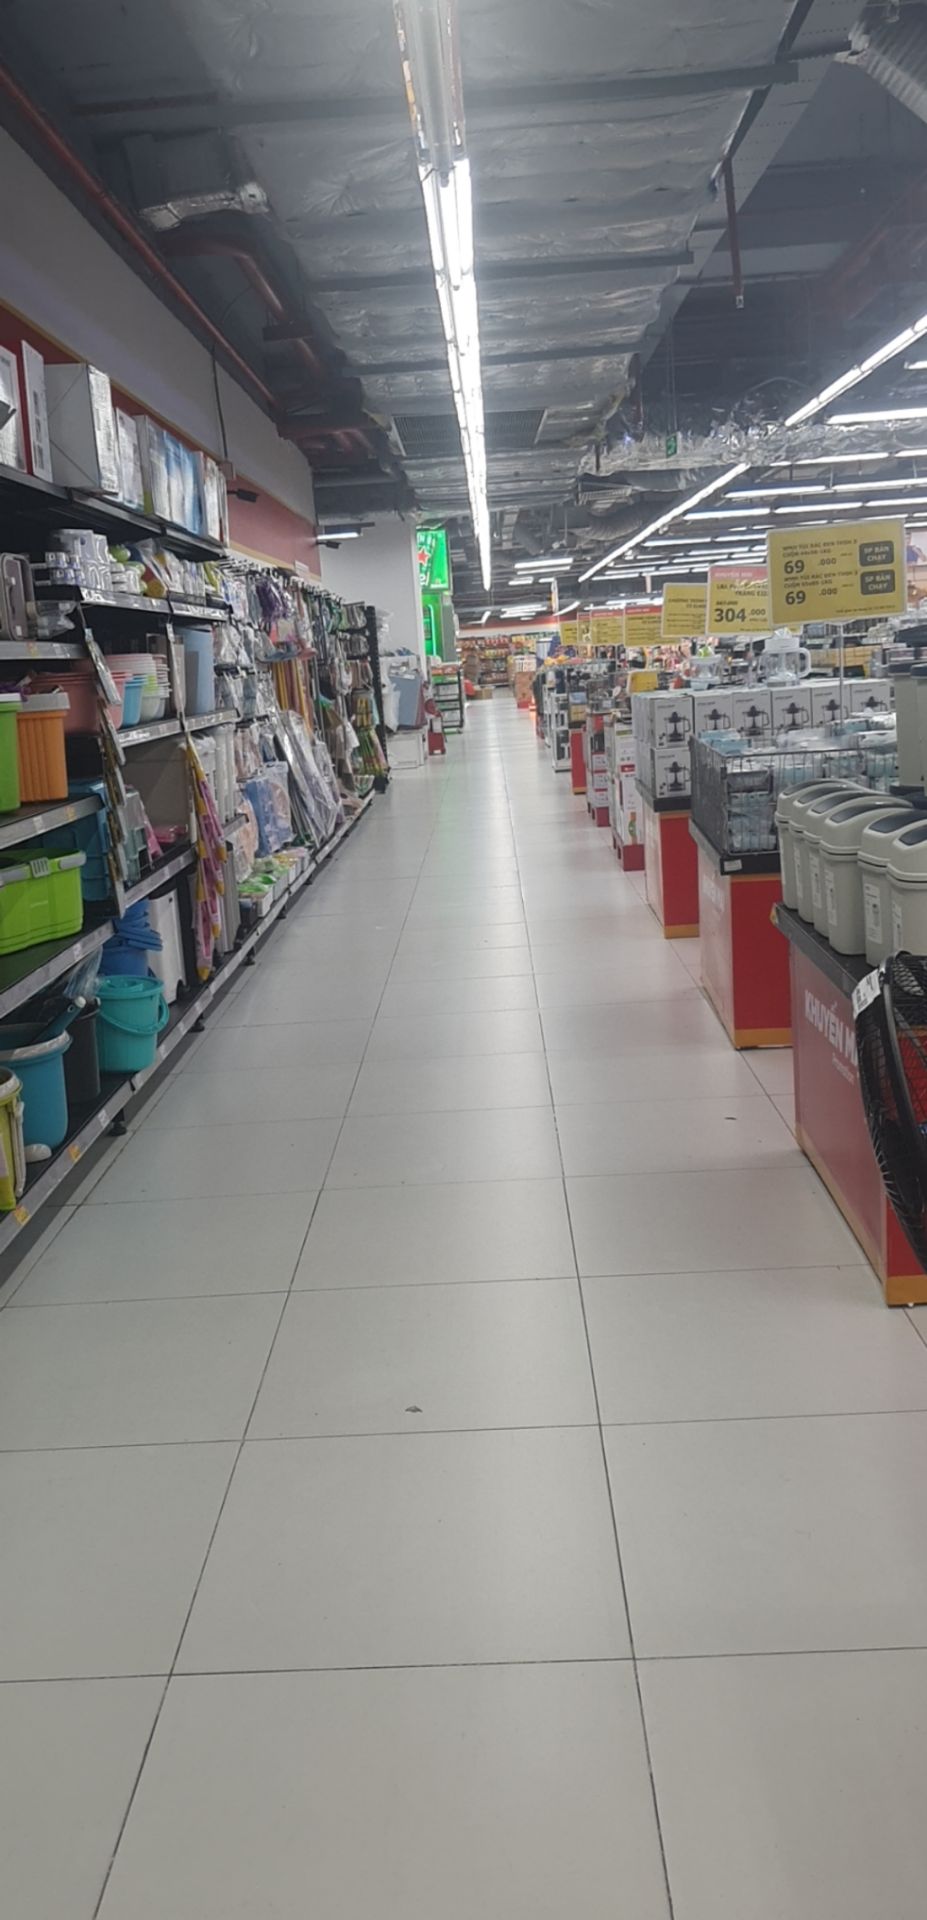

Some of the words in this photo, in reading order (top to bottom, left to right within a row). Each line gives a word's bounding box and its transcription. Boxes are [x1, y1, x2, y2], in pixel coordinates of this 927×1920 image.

[784, 559, 805, 574] 69
[785, 590, 806, 605] 69
[714, 608, 746, 623] 304
